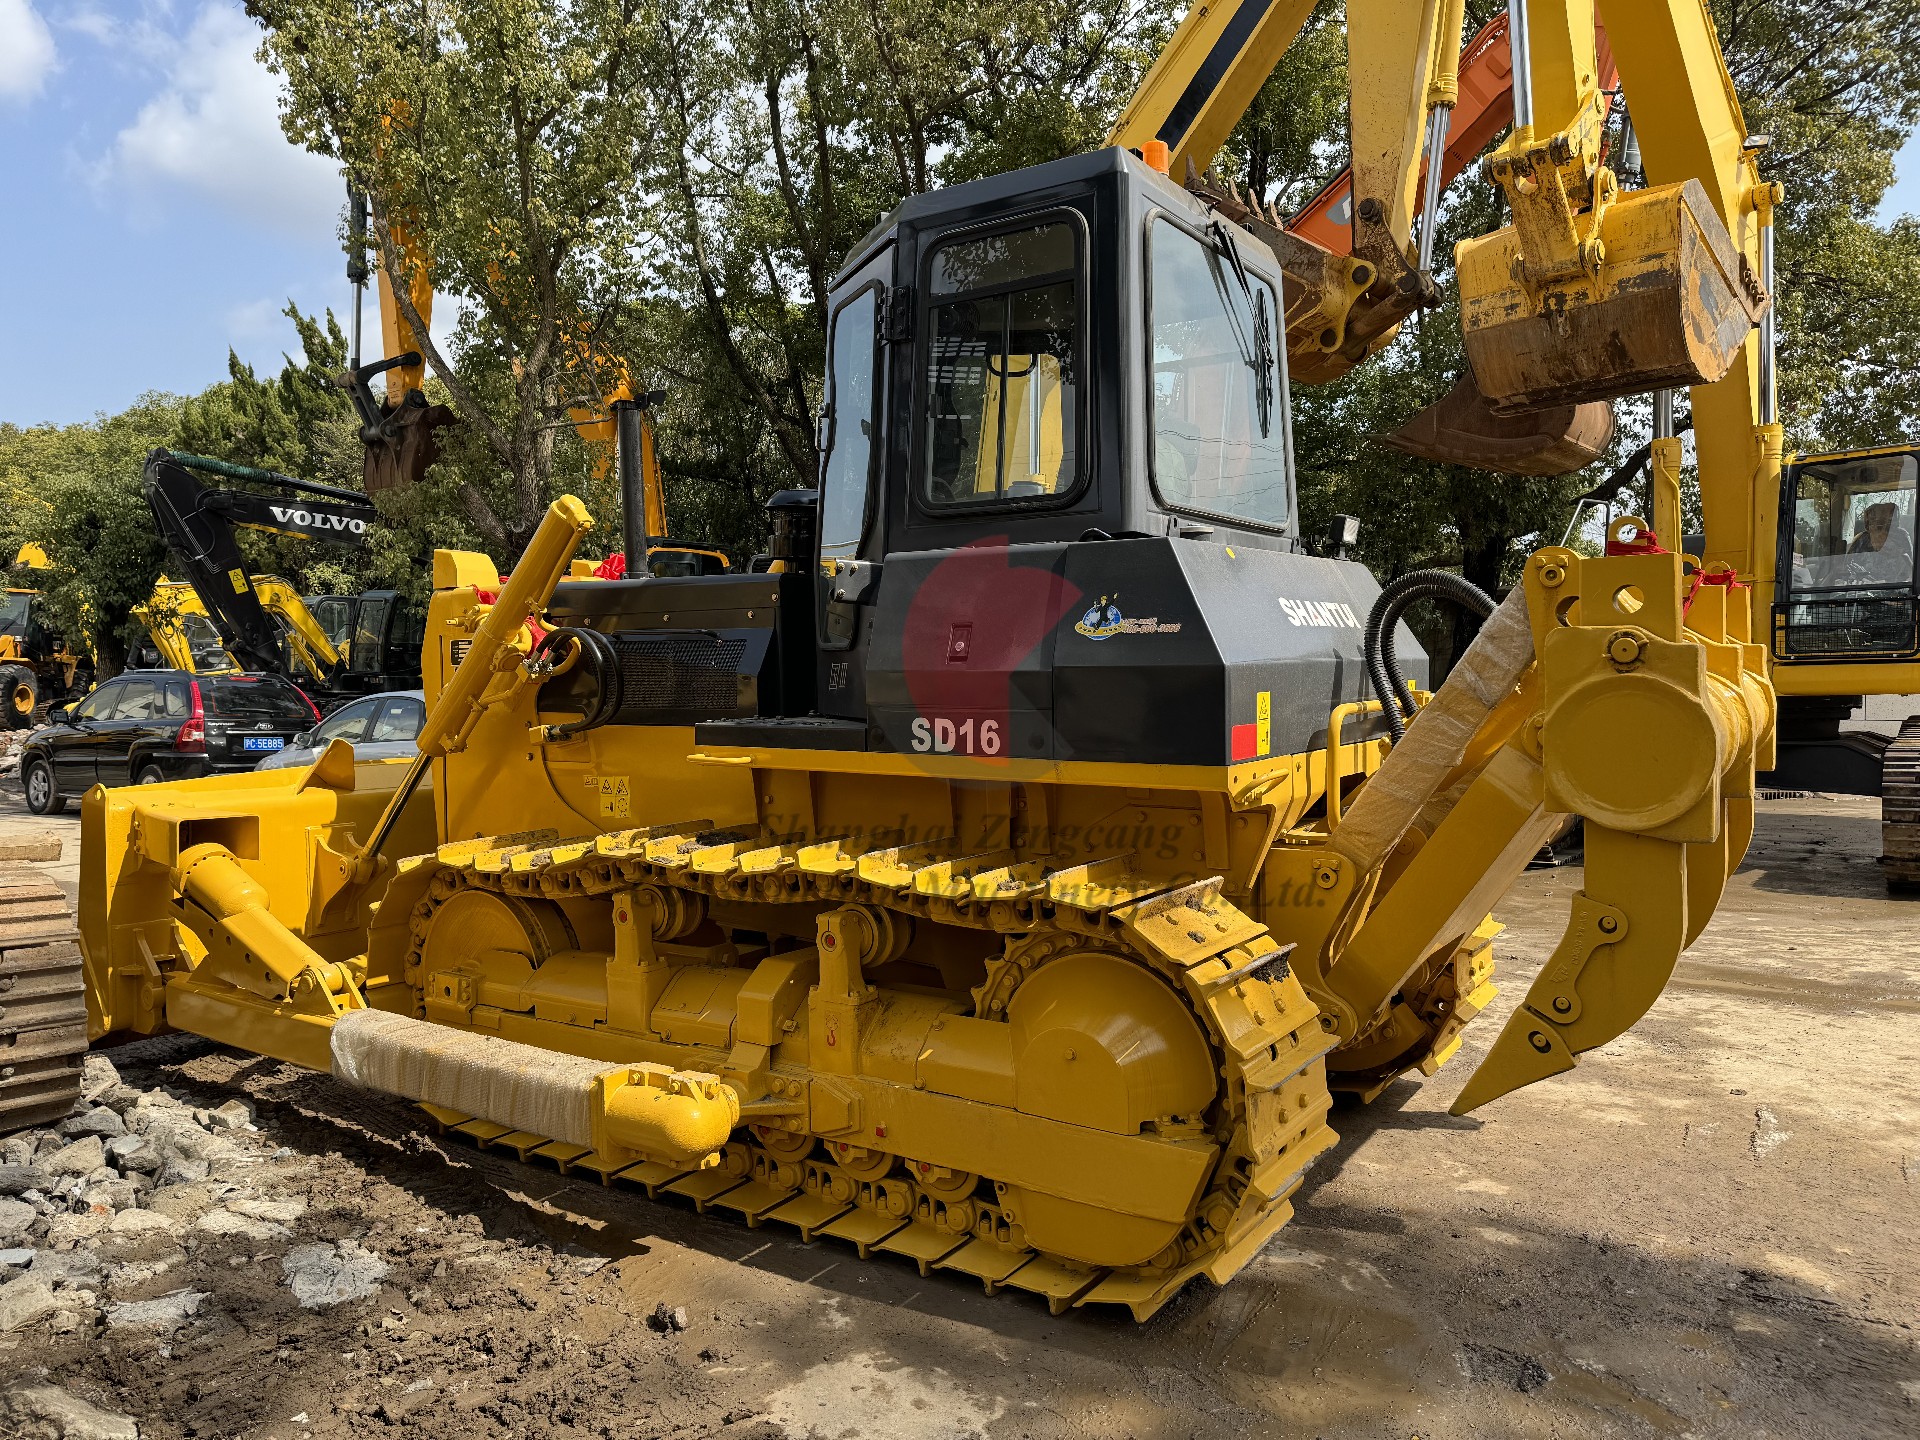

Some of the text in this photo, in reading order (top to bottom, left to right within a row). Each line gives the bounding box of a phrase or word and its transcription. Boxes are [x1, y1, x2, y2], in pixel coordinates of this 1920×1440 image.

[269, 506, 366, 534] VOLVO
[1278, 597, 1361, 629] SHANTUI
[910, 717, 1001, 755] SD16
